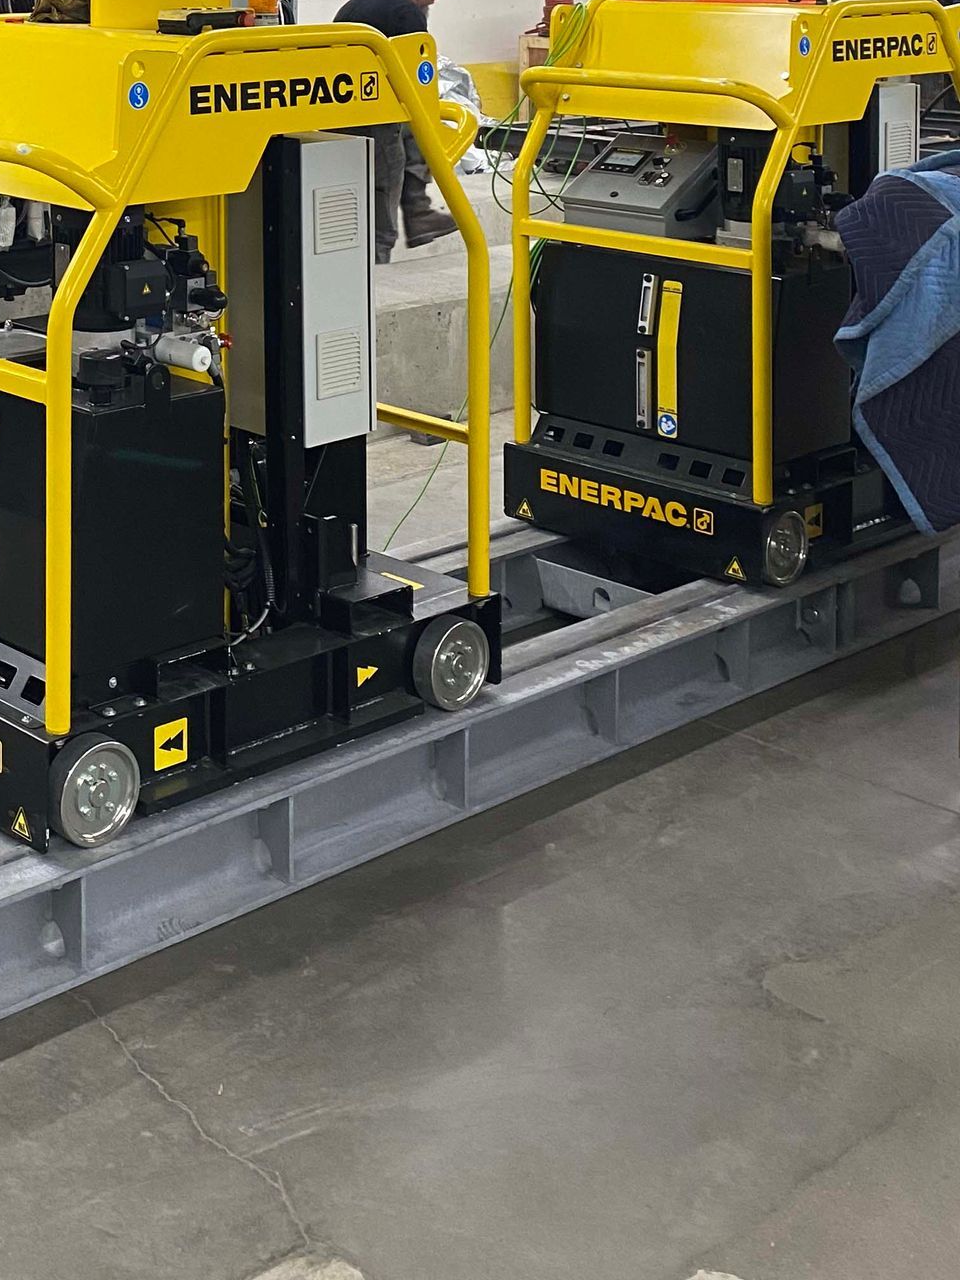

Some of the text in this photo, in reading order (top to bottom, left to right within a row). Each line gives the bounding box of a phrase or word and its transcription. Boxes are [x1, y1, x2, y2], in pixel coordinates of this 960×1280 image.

[832, 33, 923, 62] ENERPAC
[190, 72, 354, 115] ENERPAC
[540, 468, 688, 528] ENERPAC
